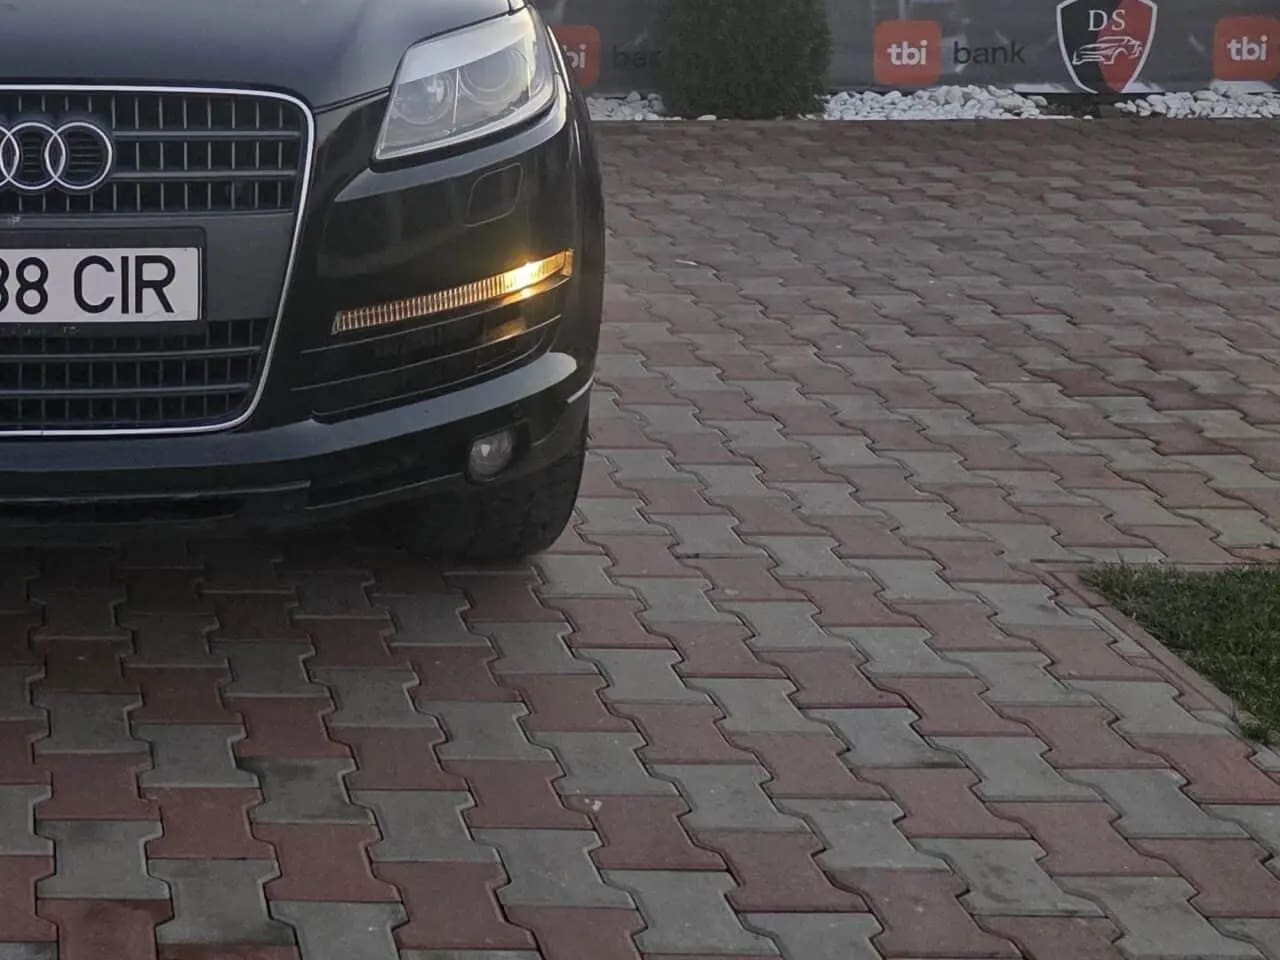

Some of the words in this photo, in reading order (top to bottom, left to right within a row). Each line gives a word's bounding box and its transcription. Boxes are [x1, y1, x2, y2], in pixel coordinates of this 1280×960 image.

[1088, 9, 1127, 31] DS
[562, 43, 587, 69] bi
[887, 40, 928, 66] tbi
[953, 41, 1025, 65] bank
[1226, 35, 1268, 61] tbi
[74, 255, 176, 315] CIR
